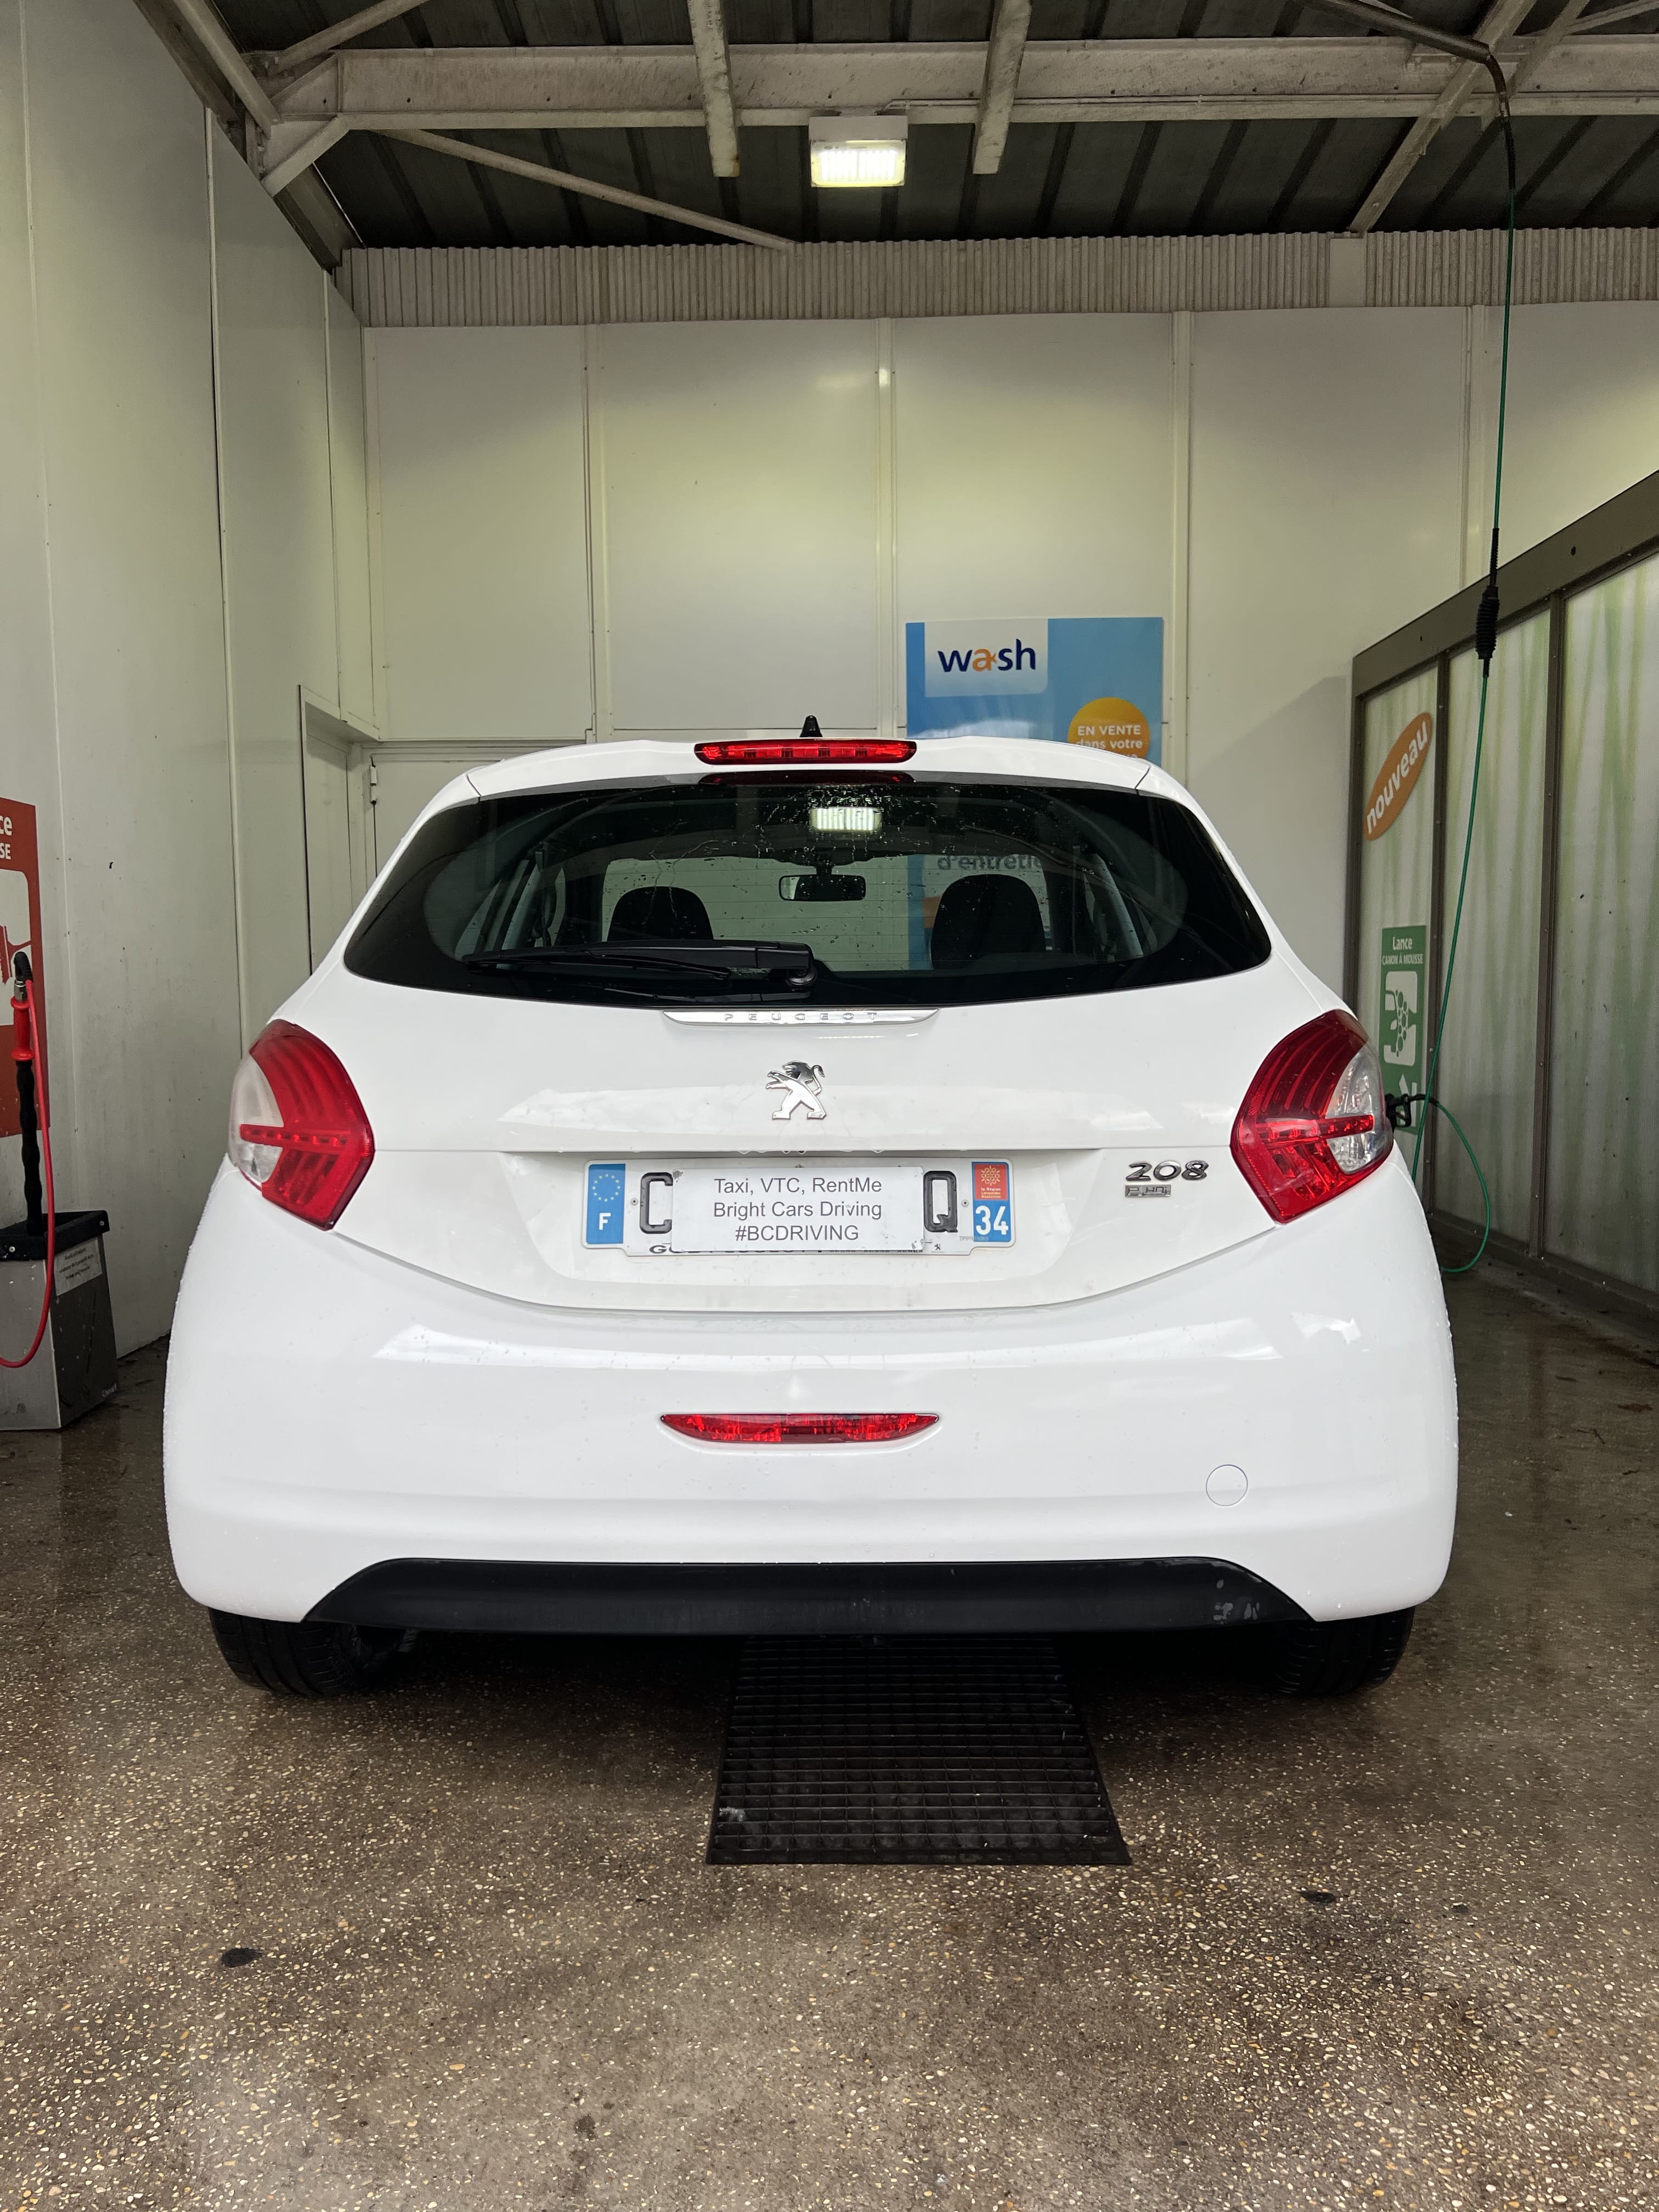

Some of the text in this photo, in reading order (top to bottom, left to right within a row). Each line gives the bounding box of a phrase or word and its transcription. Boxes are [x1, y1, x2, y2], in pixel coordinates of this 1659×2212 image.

[937, 638, 1036, 673] wash
[1077, 724, 1141, 736] EN VENTE
[1109, 739, 1143, 749] votre
[1366, 720, 1429, 834] nouveau
[1392, 935, 1413, 950] Lance
[1382, 955, 1398, 965] CANON
[1403, 953, 1423, 964] MOUSSE
[724, 1012, 877, 1021] PEUGEOT
[1125, 1160, 1209, 1182] 208
[714, 1177, 882, 1195] Taxi, VTC, RentMe
[640, 1172, 674, 1234] C
[714, 1201, 882, 1221] Bright Cars Driving
[923, 1170, 958, 1233] Q
[599, 1212, 612, 1231] F
[975, 1205, 1009, 1235] 34
[735, 1224, 859, 1241] #BCDRIVING
